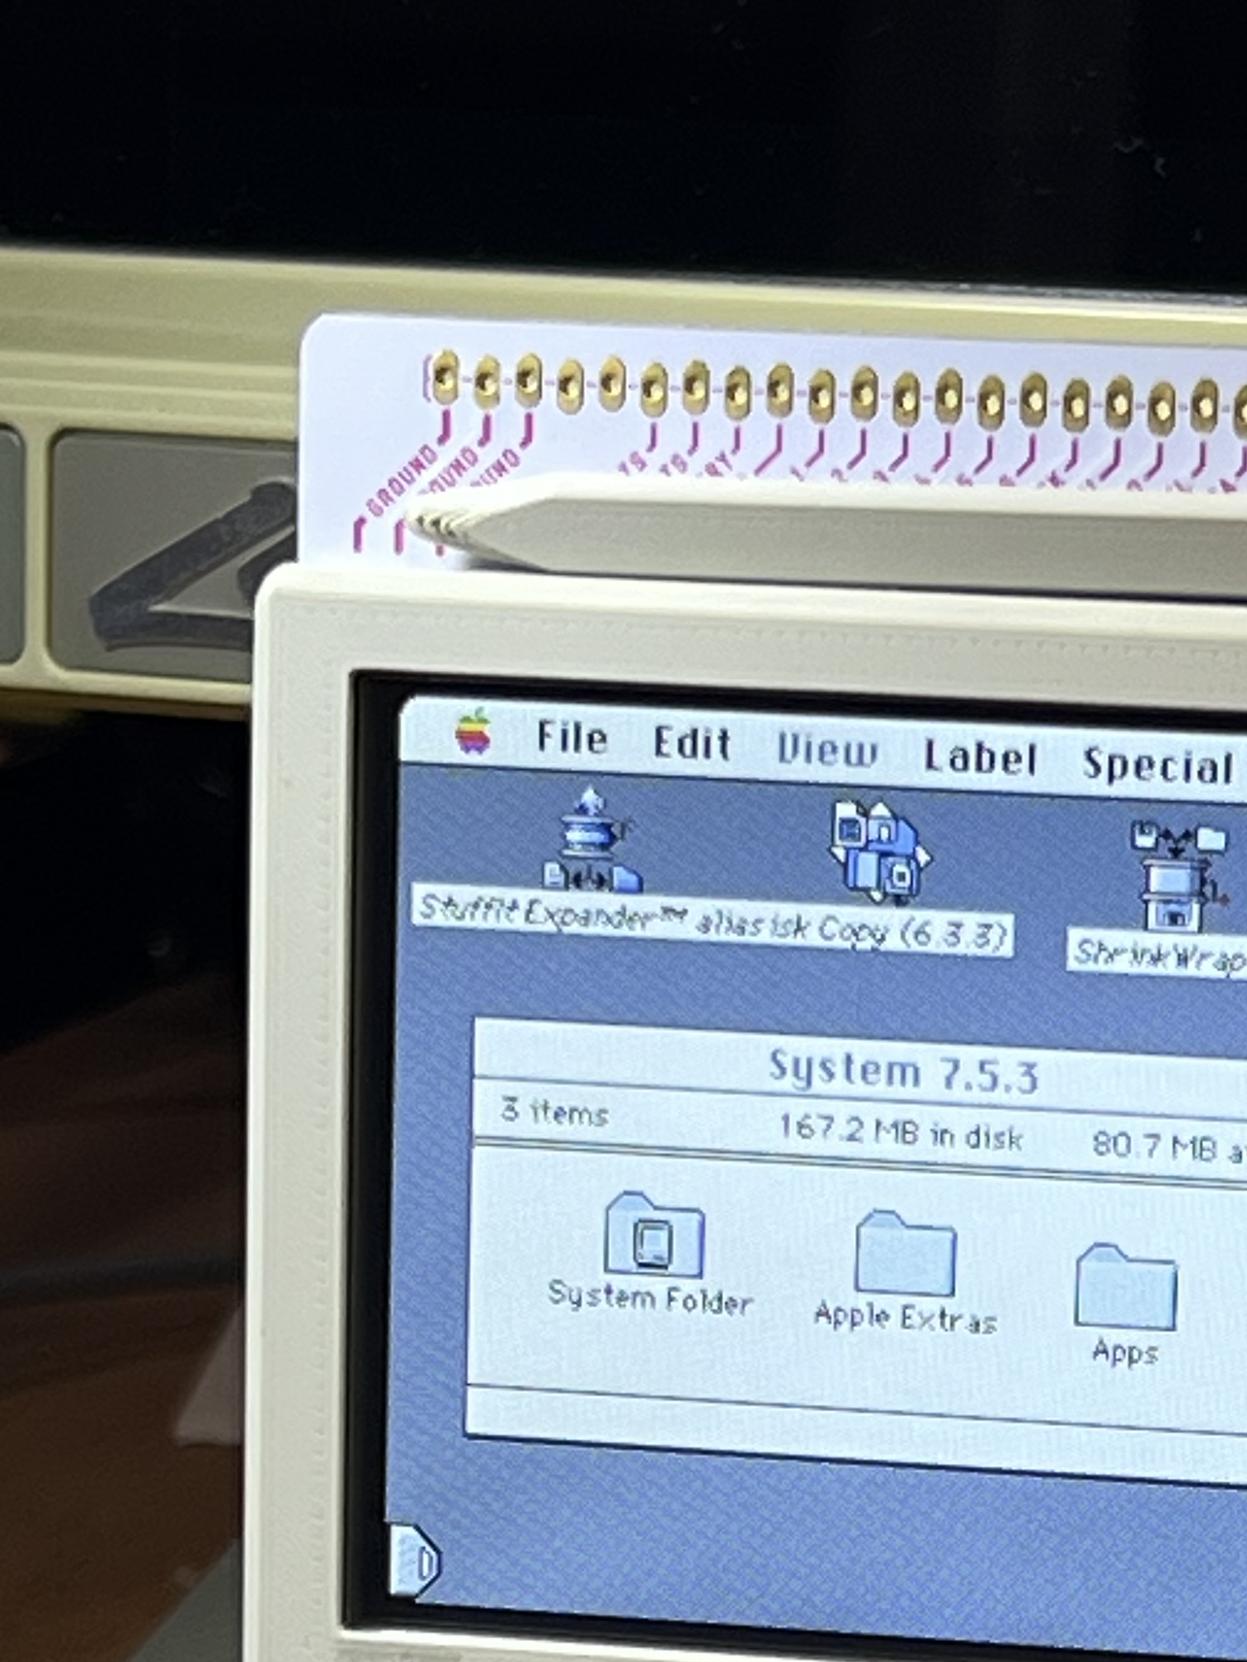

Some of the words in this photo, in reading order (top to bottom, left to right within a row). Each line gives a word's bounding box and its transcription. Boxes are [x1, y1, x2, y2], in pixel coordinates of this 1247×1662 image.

[365, 443, 438, 518] GROUND
[538, 719, 609, 755] File
[653, 725, 731, 762] Edit
[778, 730, 879, 768] View
[924, 736, 1037, 776] Label
[1082, 745, 1235, 788] Special
[818, 915, 889, 954] Copy
[769, 1047, 921, 1091] System
[940, 1057, 1041, 1096] 7.5.3
[500, 1096, 519, 1122] 3
[529, 1099, 610, 1128] items
[779, 1113, 865, 1146] 167.2
[873, 1118, 919, 1147] MB
[929, 1122, 956, 1150] in
[965, 1127, 1024, 1152] disk
[1091, 1132, 1161, 1160] 80.7
[1170, 1137, 1218, 1163] MB
[547, 1279, 657, 1312] System
[665, 1285, 754, 1317] Folder
[813, 1300, 892, 1338] Apple
[899, 1304, 999, 1336] Extras
[1091, 1337, 1159, 1369] Apps
